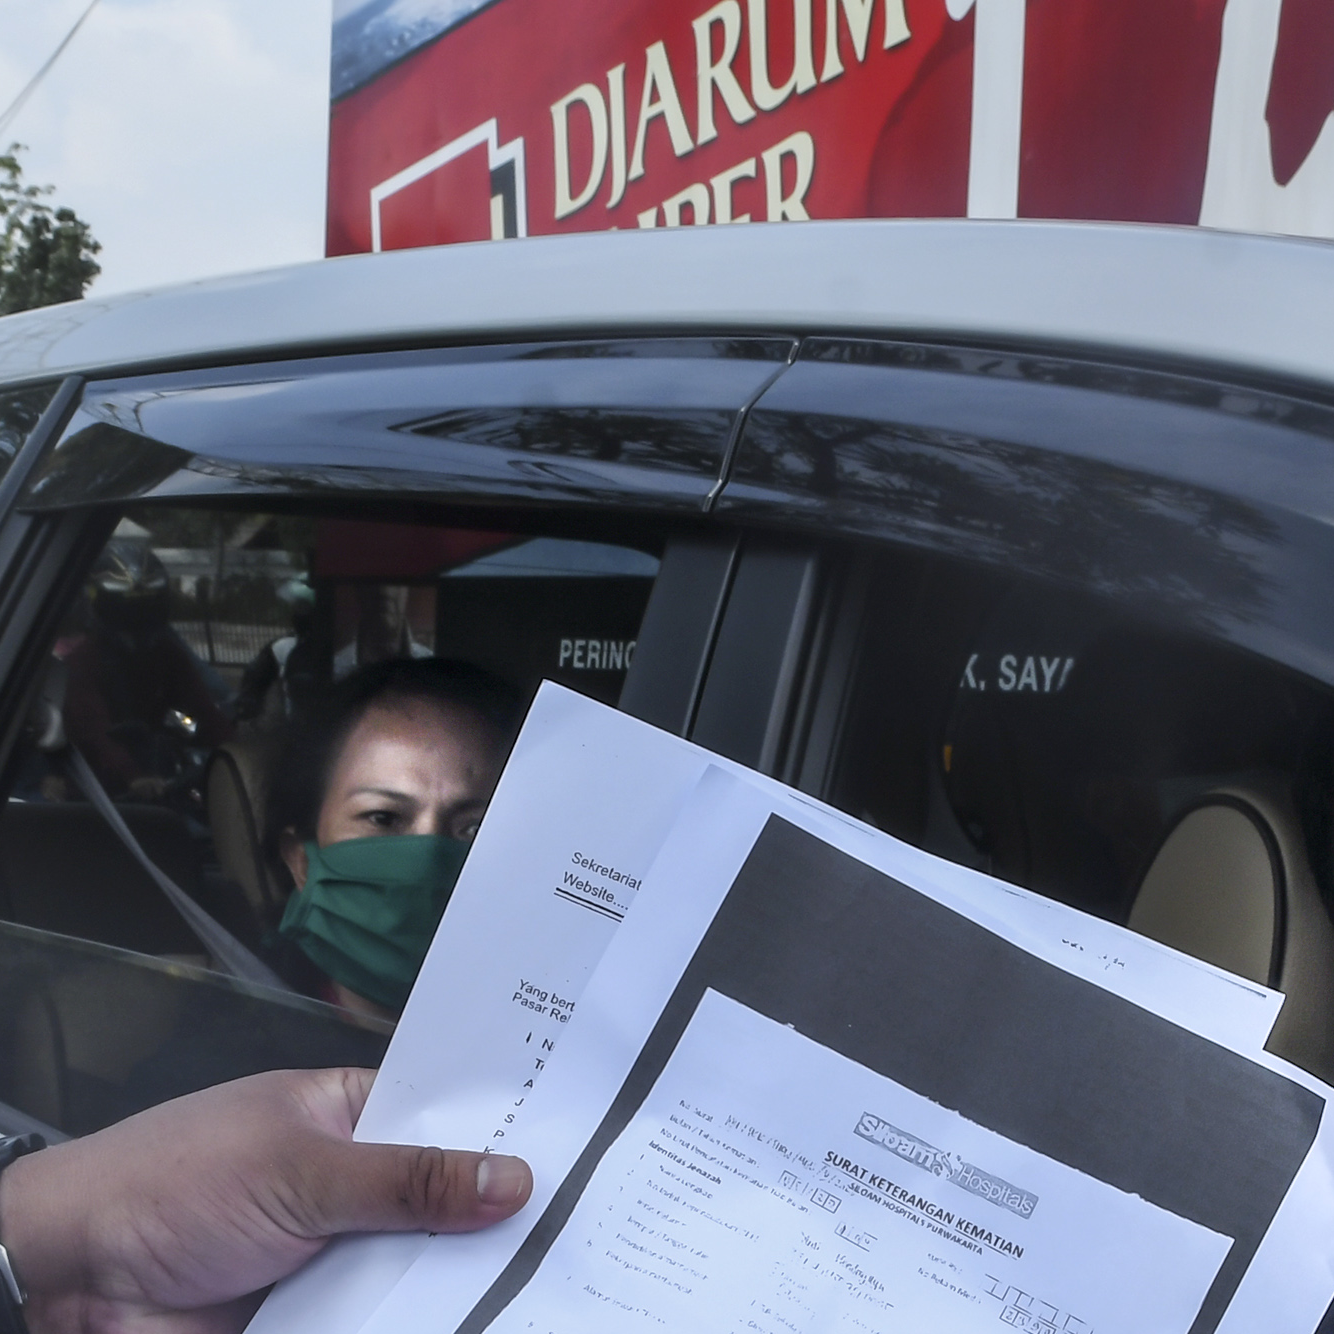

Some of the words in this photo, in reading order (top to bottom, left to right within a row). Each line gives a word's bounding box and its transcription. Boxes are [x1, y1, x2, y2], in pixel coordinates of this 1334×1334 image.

[551, 0, 911, 220] DJARUM
[571, 851, 643, 891] Sekretariat
[512, 992, 548, 1015] Pasar
[519, 979, 548, 1001] Yang
[824, 1150, 868, 1181] SURAT
[868, 1173, 955, 1225] KETERANGAN
[955, 1217, 1025, 1259] KEMATIAN
[957, 1164, 1037, 1216] Hospitals
[926, 1219, 983, 1256] PURWAKARTA
